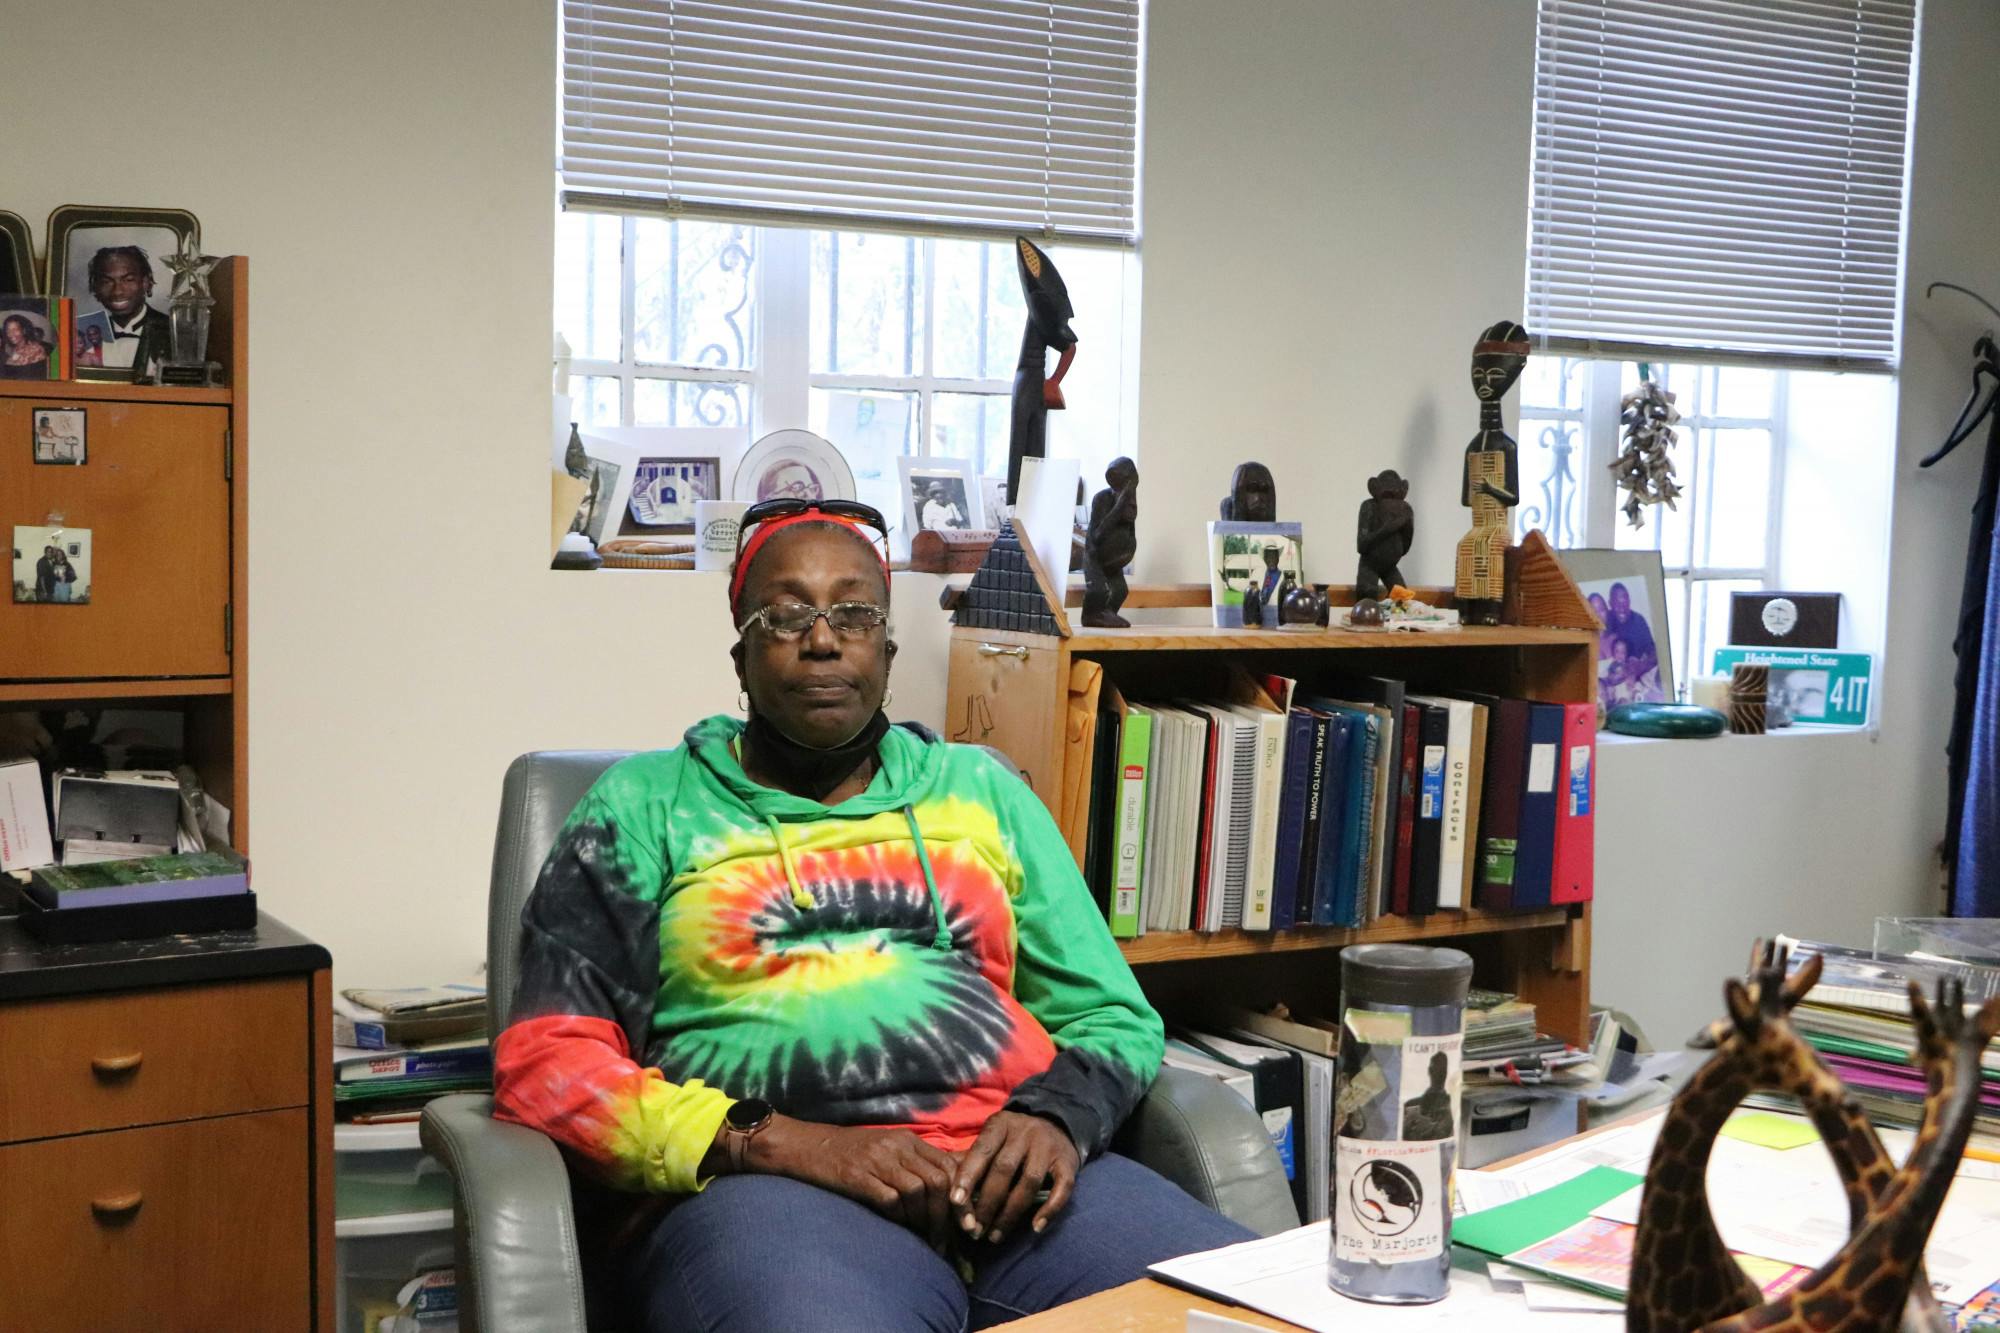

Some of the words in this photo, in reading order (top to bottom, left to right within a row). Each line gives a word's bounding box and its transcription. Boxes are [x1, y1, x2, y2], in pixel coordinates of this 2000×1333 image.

[1743, 652, 1808, 666] Heightened
[1810, 654, 1839, 666] State
[1317, 724, 1325, 748] SPEAK
[1313, 750, 1323, 777] TRUTH
[1312, 778, 1320, 790] TO
[1126, 796, 1137, 832] durable
[1310, 792, 1319, 820] POWER
[1450, 762, 1463, 841] Contracts
[1342, 1235, 1364, 1248] The
[1372, 1234, 1438, 1250] Marjorie
